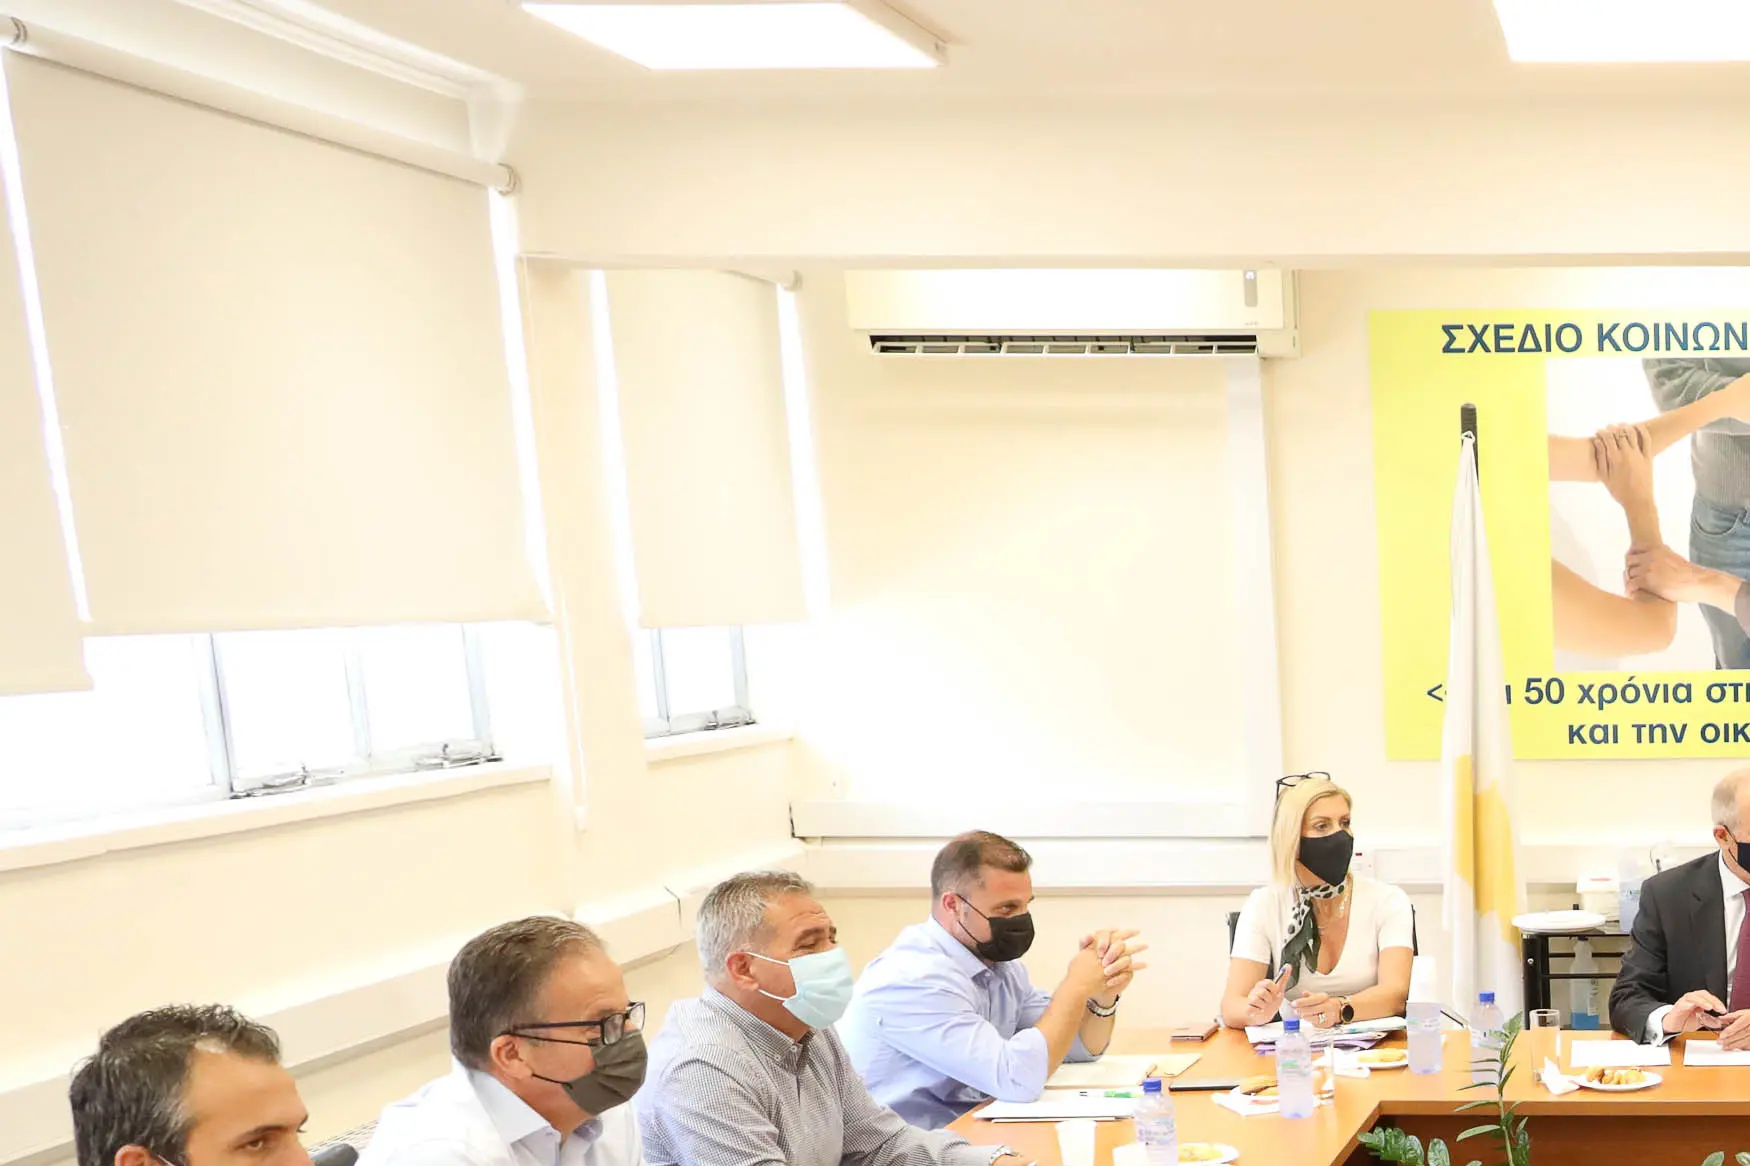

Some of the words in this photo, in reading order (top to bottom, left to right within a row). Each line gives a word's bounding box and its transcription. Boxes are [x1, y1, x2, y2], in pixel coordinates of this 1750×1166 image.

[1441, 322, 1583, 354] ΣΧΕΔΙΟ
[1523, 677, 1565, 705] 50
[1577, 675, 1692, 711] χρόνια
[1568, 723, 1619, 745] και
[1631, 723, 1688, 744] την
